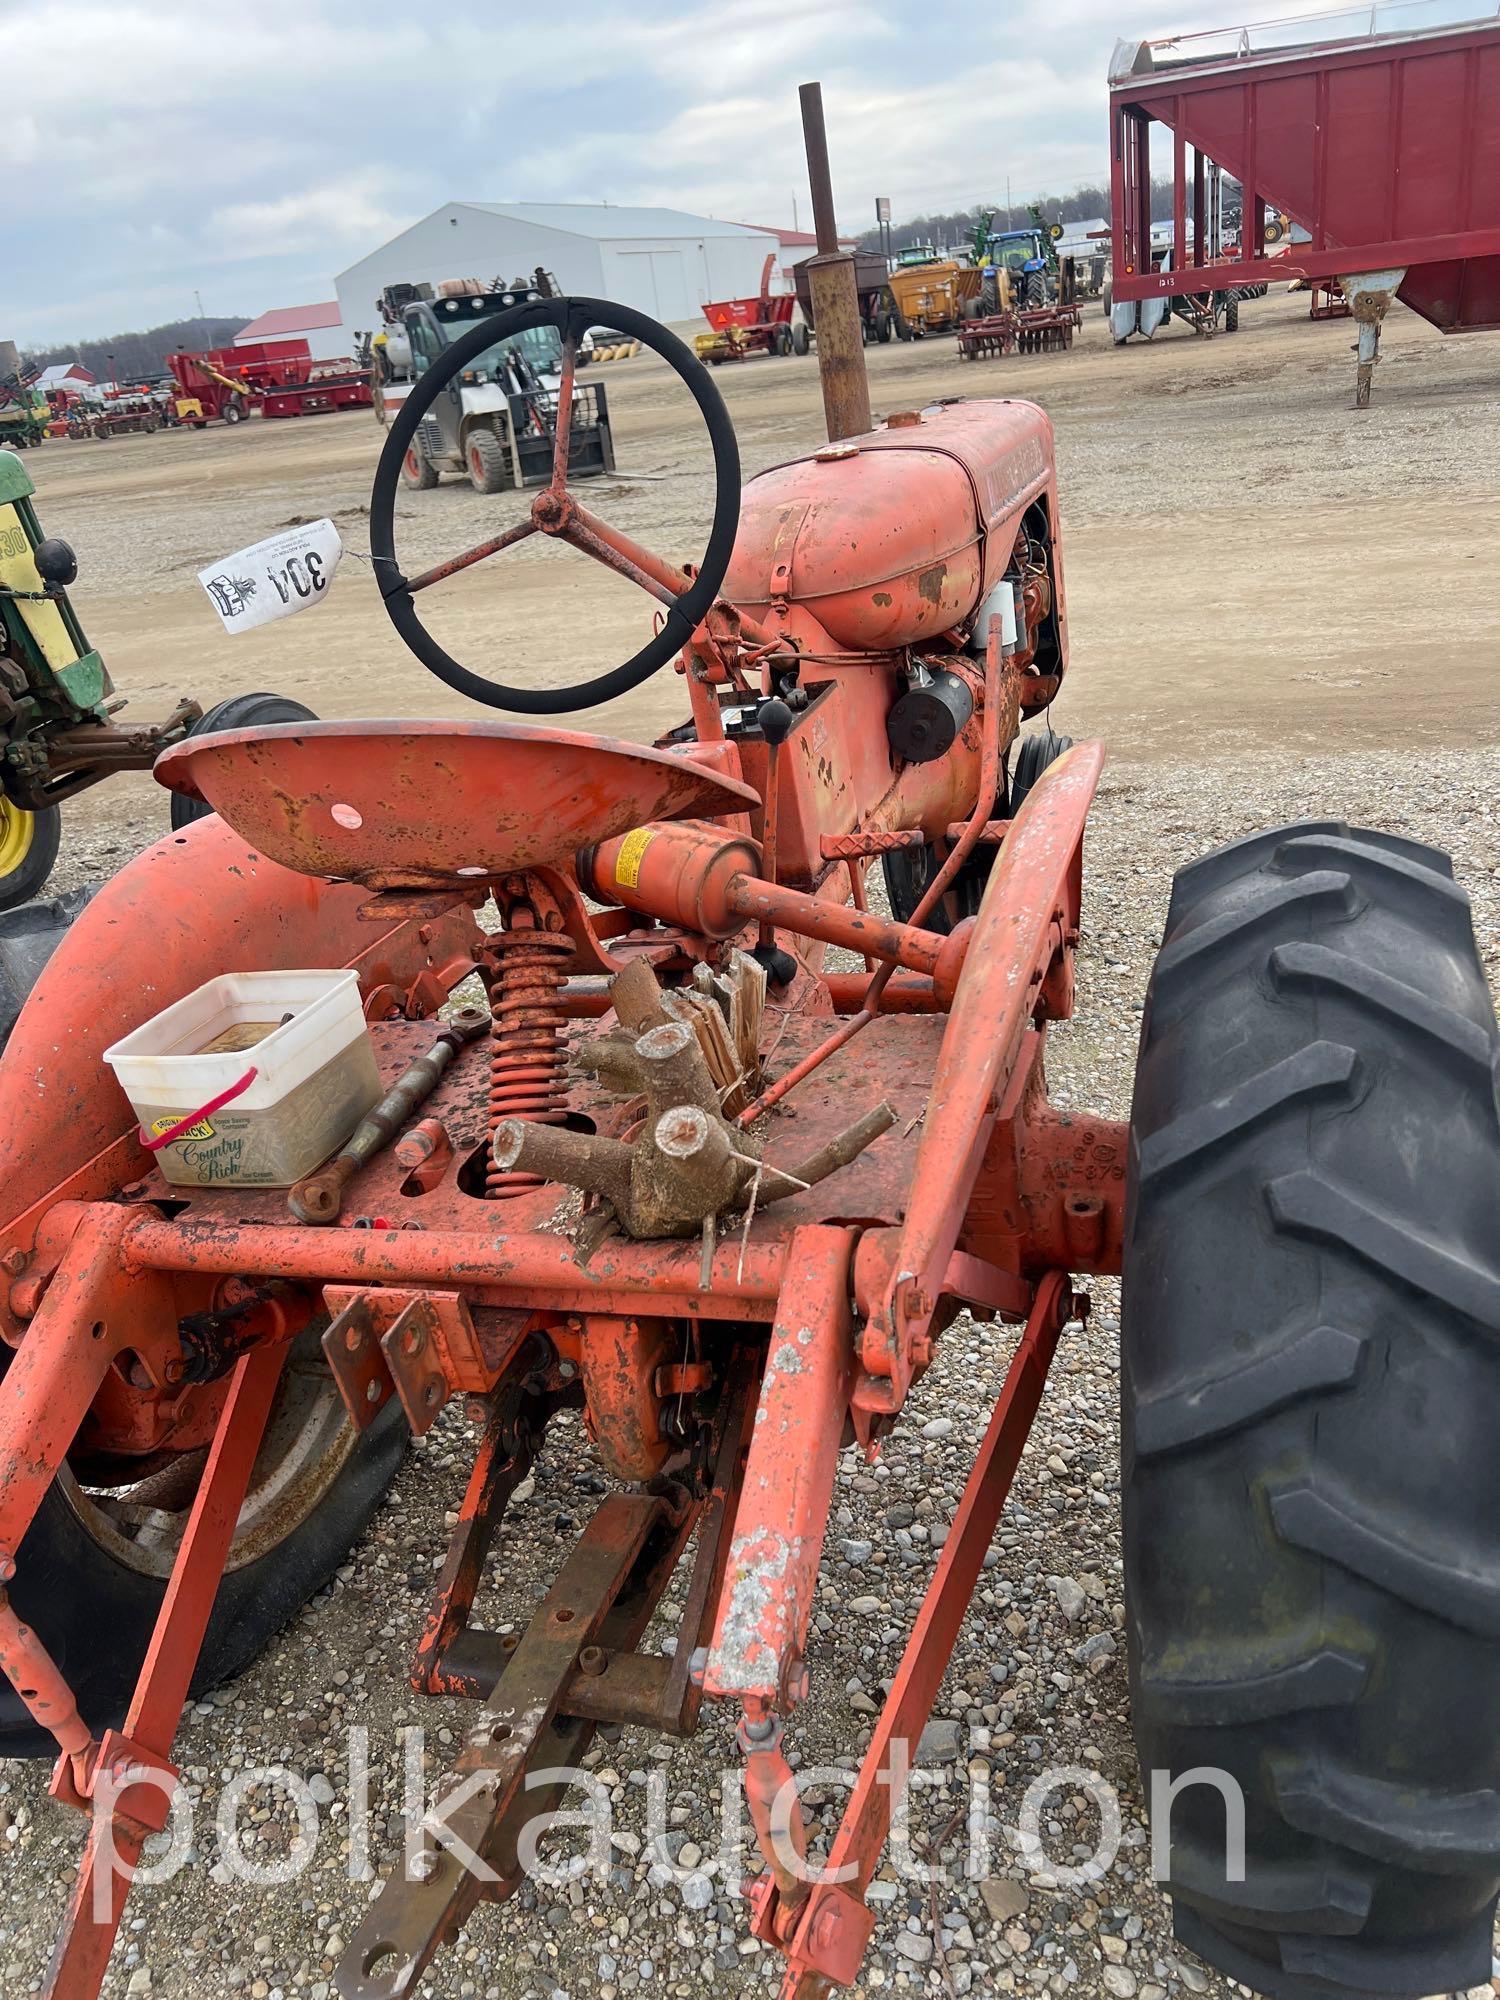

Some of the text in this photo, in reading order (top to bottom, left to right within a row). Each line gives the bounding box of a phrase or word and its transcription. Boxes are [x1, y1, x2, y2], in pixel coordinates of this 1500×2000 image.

[0, 527, 27, 558] 30
[211, 574, 245, 616] POLK
[176, 1137, 243, 1166] Country
[198, 1157, 240, 1183] Rich
